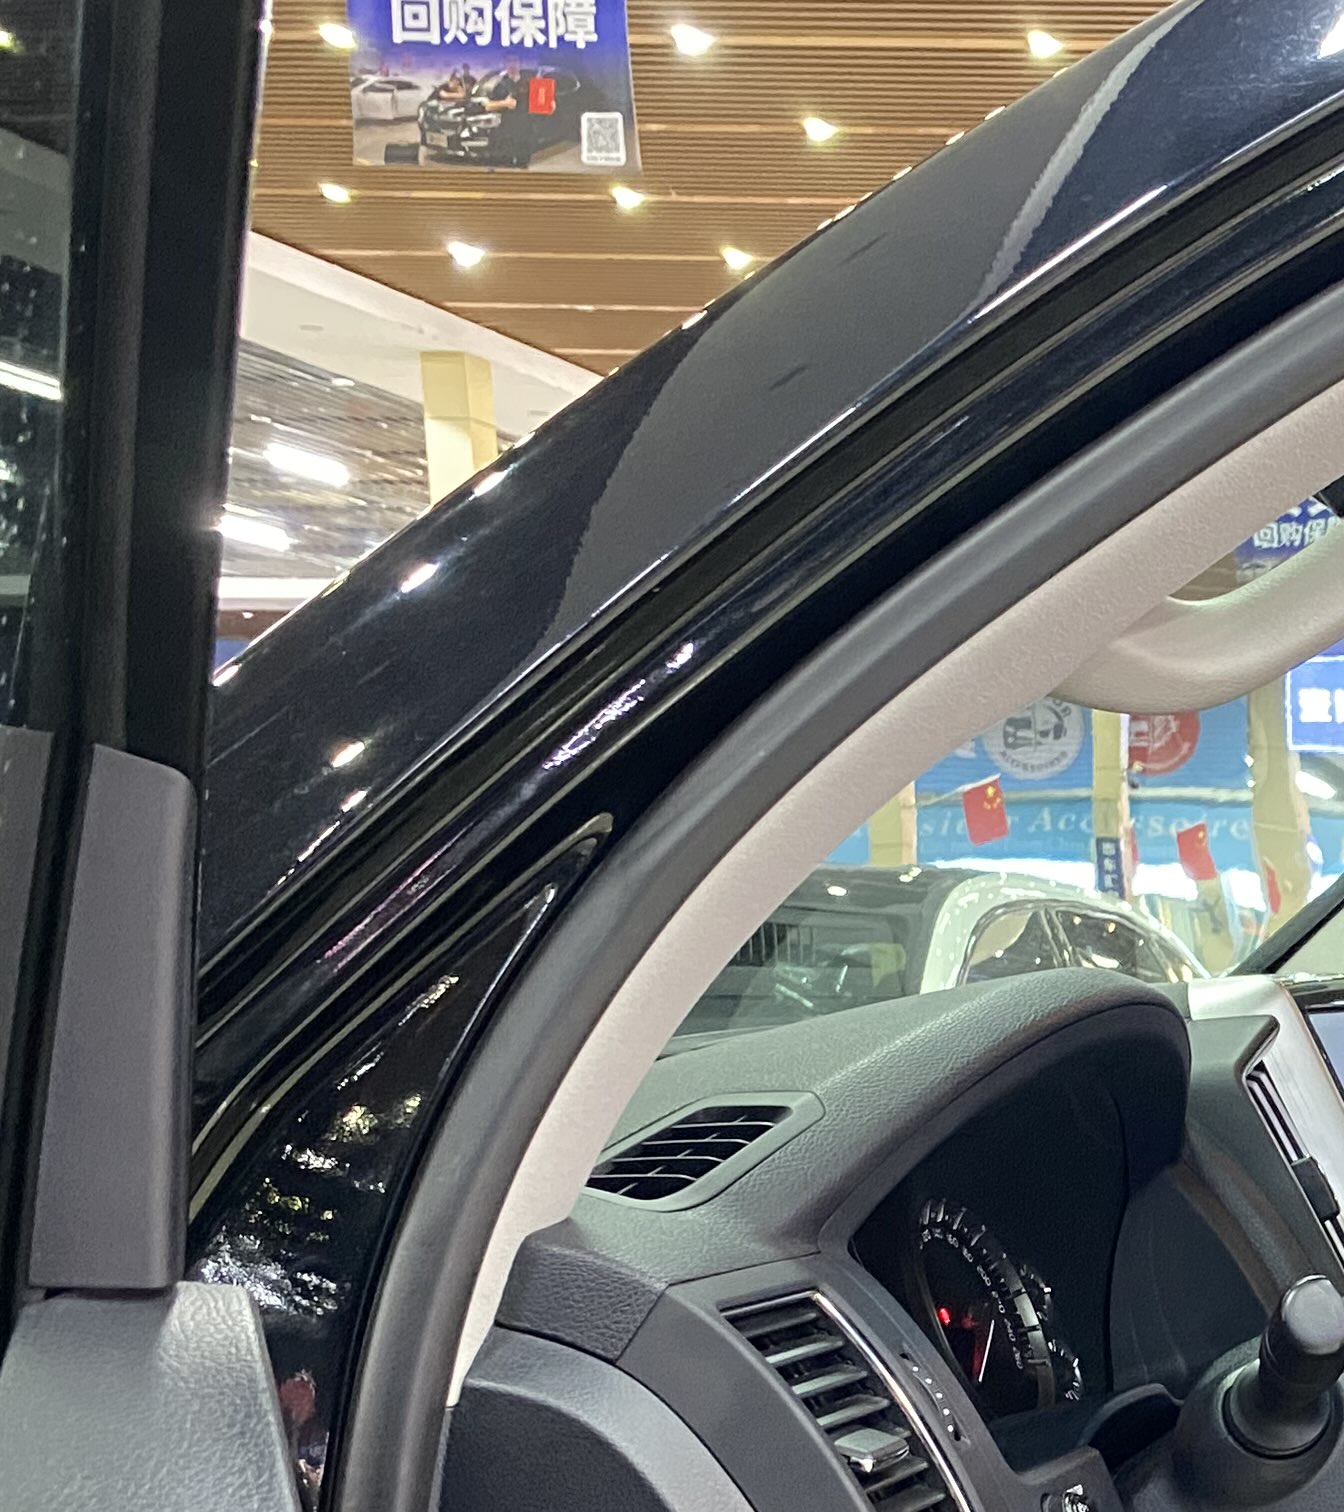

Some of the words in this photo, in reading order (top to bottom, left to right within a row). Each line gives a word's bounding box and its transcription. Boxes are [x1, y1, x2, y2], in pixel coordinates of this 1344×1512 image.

[391, 0, 599, 49] 回购保障
[1253, 517, 1338, 549] 回购保
